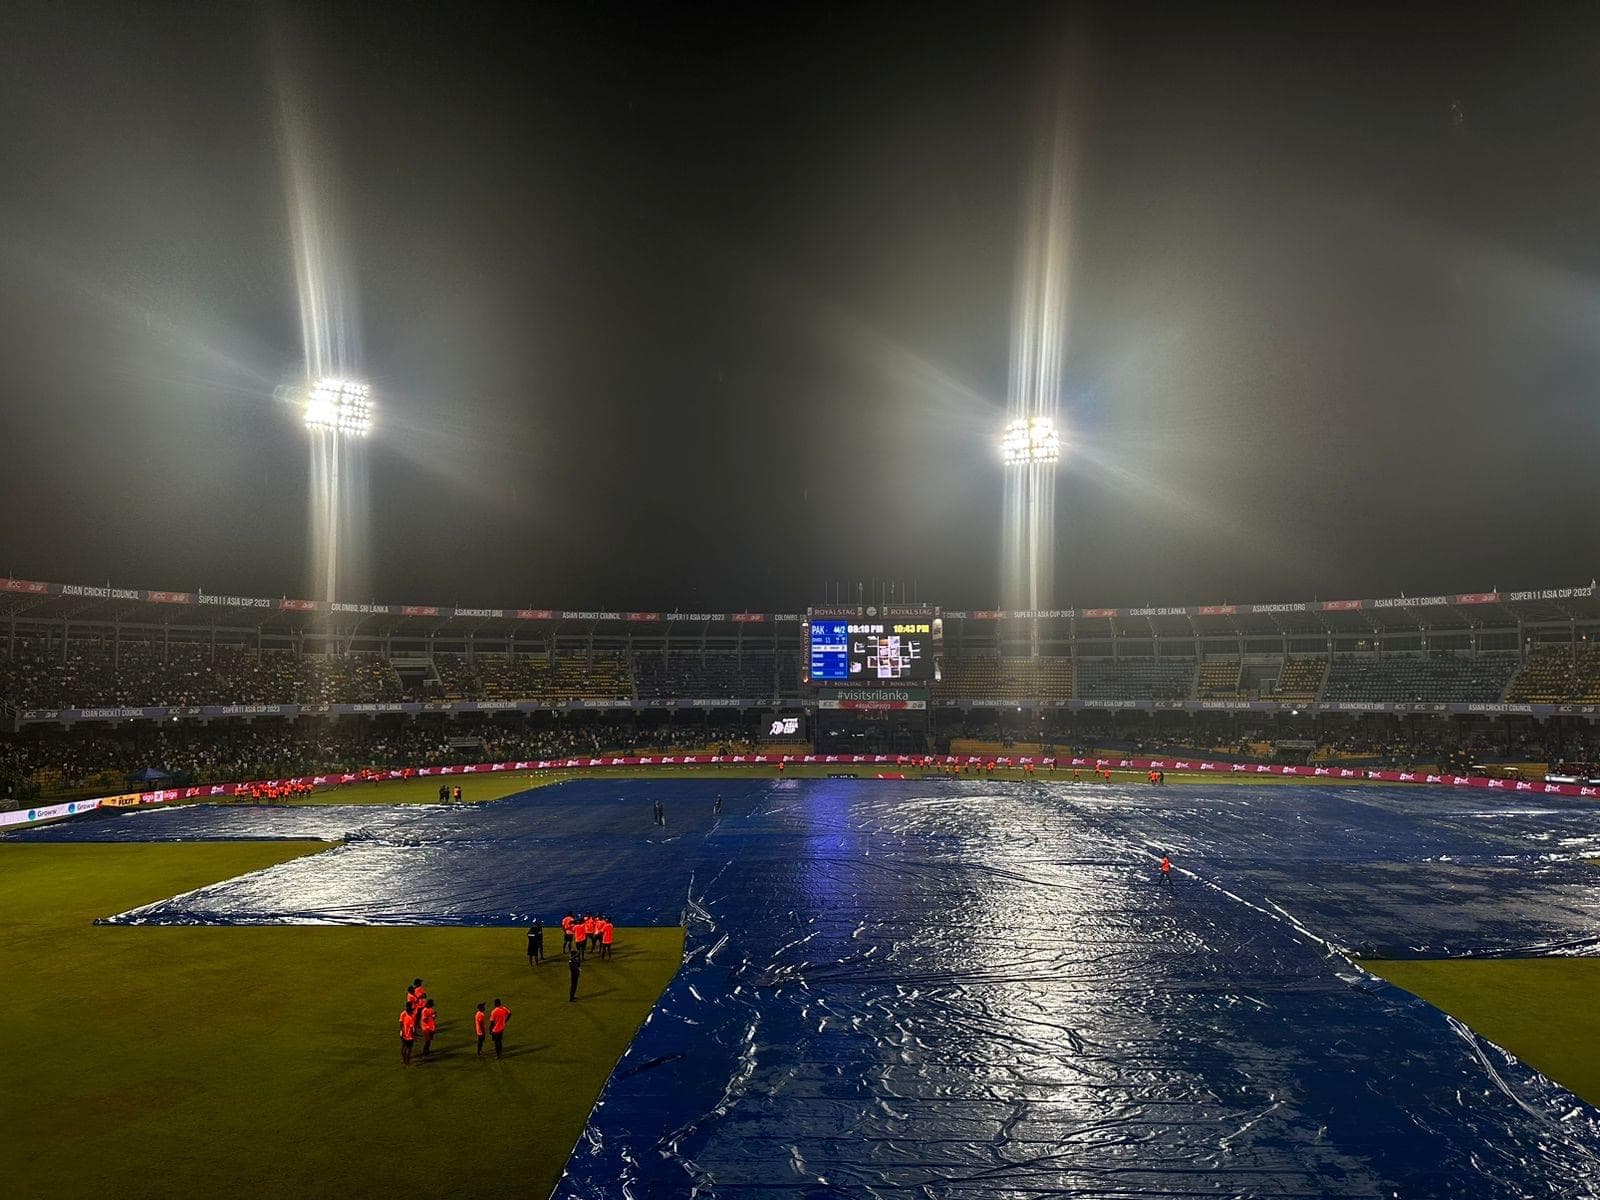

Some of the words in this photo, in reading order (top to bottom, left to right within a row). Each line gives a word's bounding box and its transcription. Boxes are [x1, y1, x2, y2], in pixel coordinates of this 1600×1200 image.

[62, 585, 83, 595] ASIAN
[83, 586, 111, 598] CRICKET
[112, 589, 139, 600] COUNCIL
[1542, 590, 1558, 599] ASIA
[1558, 589, 1572, 598] CUP
[1573, 587, 1592, 597] 2023
[226, 596, 240, 605] ASIA
[241, 598, 254, 607] CUP
[254, 599, 270, 608] 2023
[1374, 599, 1393, 608] ASIAN
[1393, 598, 1420, 606] CRICKET
[1420, 596, 1448, 605] COUNCIL
[359, 604, 369, 613] SRI
[369, 605, 389, 614] LANKA
[1167, 607, 1186, 615] LANKA
[562, 611, 578, 619] ASIAN
[578, 612, 599, 620] CRICKET
[600, 612, 621, 620] COUNCIL
[1049, 610, 1061, 618] CUP
[1061, 610, 1075, 618] 2023
[811, 625, 825, 635] PAK
[870, 624, 884, 633] PM
[916, 624, 930, 633] PM
[837, 689, 909, 700] #visitsrilanka
[245, 705, 256, 713] ASIA
[267, 704, 280, 712] 2023
[1468, 703, 1485, 711] ASIAN
[1486, 703, 1508, 711] CRICKET
[1509, 703, 1532, 712] COUNCIL
[81, 710, 98, 718] ASIAN
[37, 808, 57, 817] Groww
